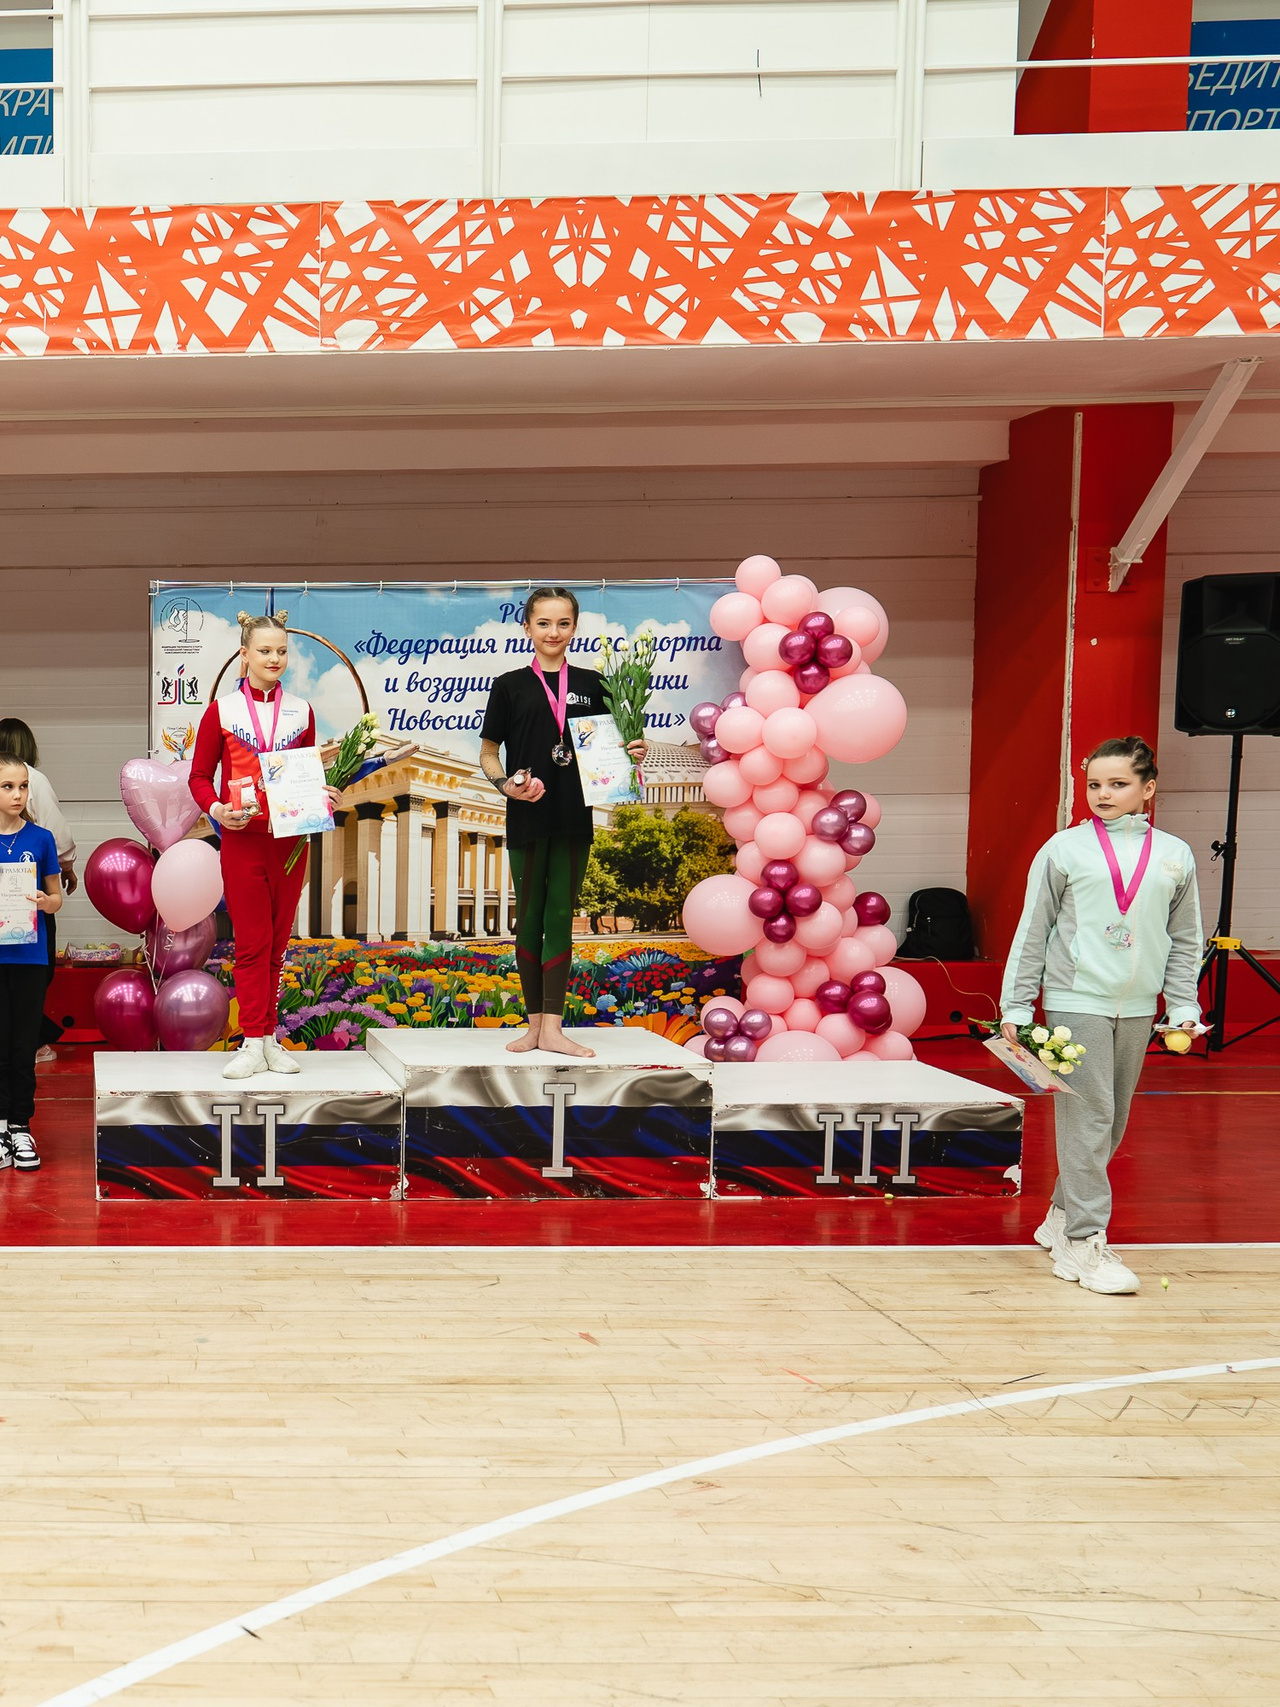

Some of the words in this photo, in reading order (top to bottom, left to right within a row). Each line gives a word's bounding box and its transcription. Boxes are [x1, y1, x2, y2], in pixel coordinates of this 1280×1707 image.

[1186, 108, 1280, 131] ПОРТ
[354, 630, 497, 665] «Федерация
[384, 677, 400, 692] и
[406, 671, 497, 703] воздуш
[212, 1104, 285, 1187] II
[542, 1084, 576, 1177] I
[816, 1113, 919, 1184] III
